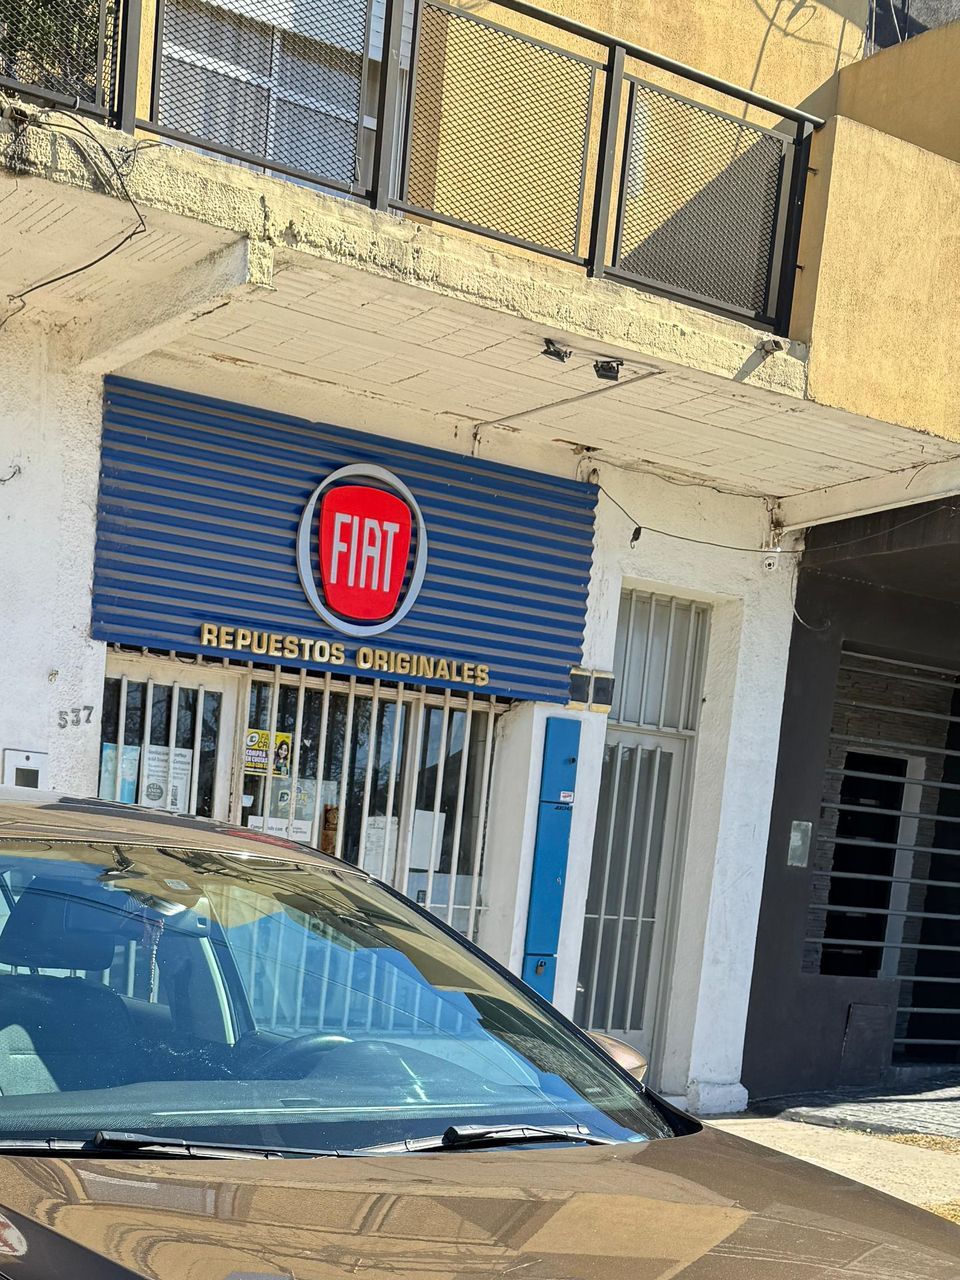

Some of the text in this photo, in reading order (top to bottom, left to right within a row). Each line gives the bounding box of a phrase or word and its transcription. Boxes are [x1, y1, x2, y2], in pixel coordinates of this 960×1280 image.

[329, 511, 400, 593] FIAT
[200, 622, 490, 687] REPUESTOS ORIGINALES
[57, 705, 94, 731] 537
